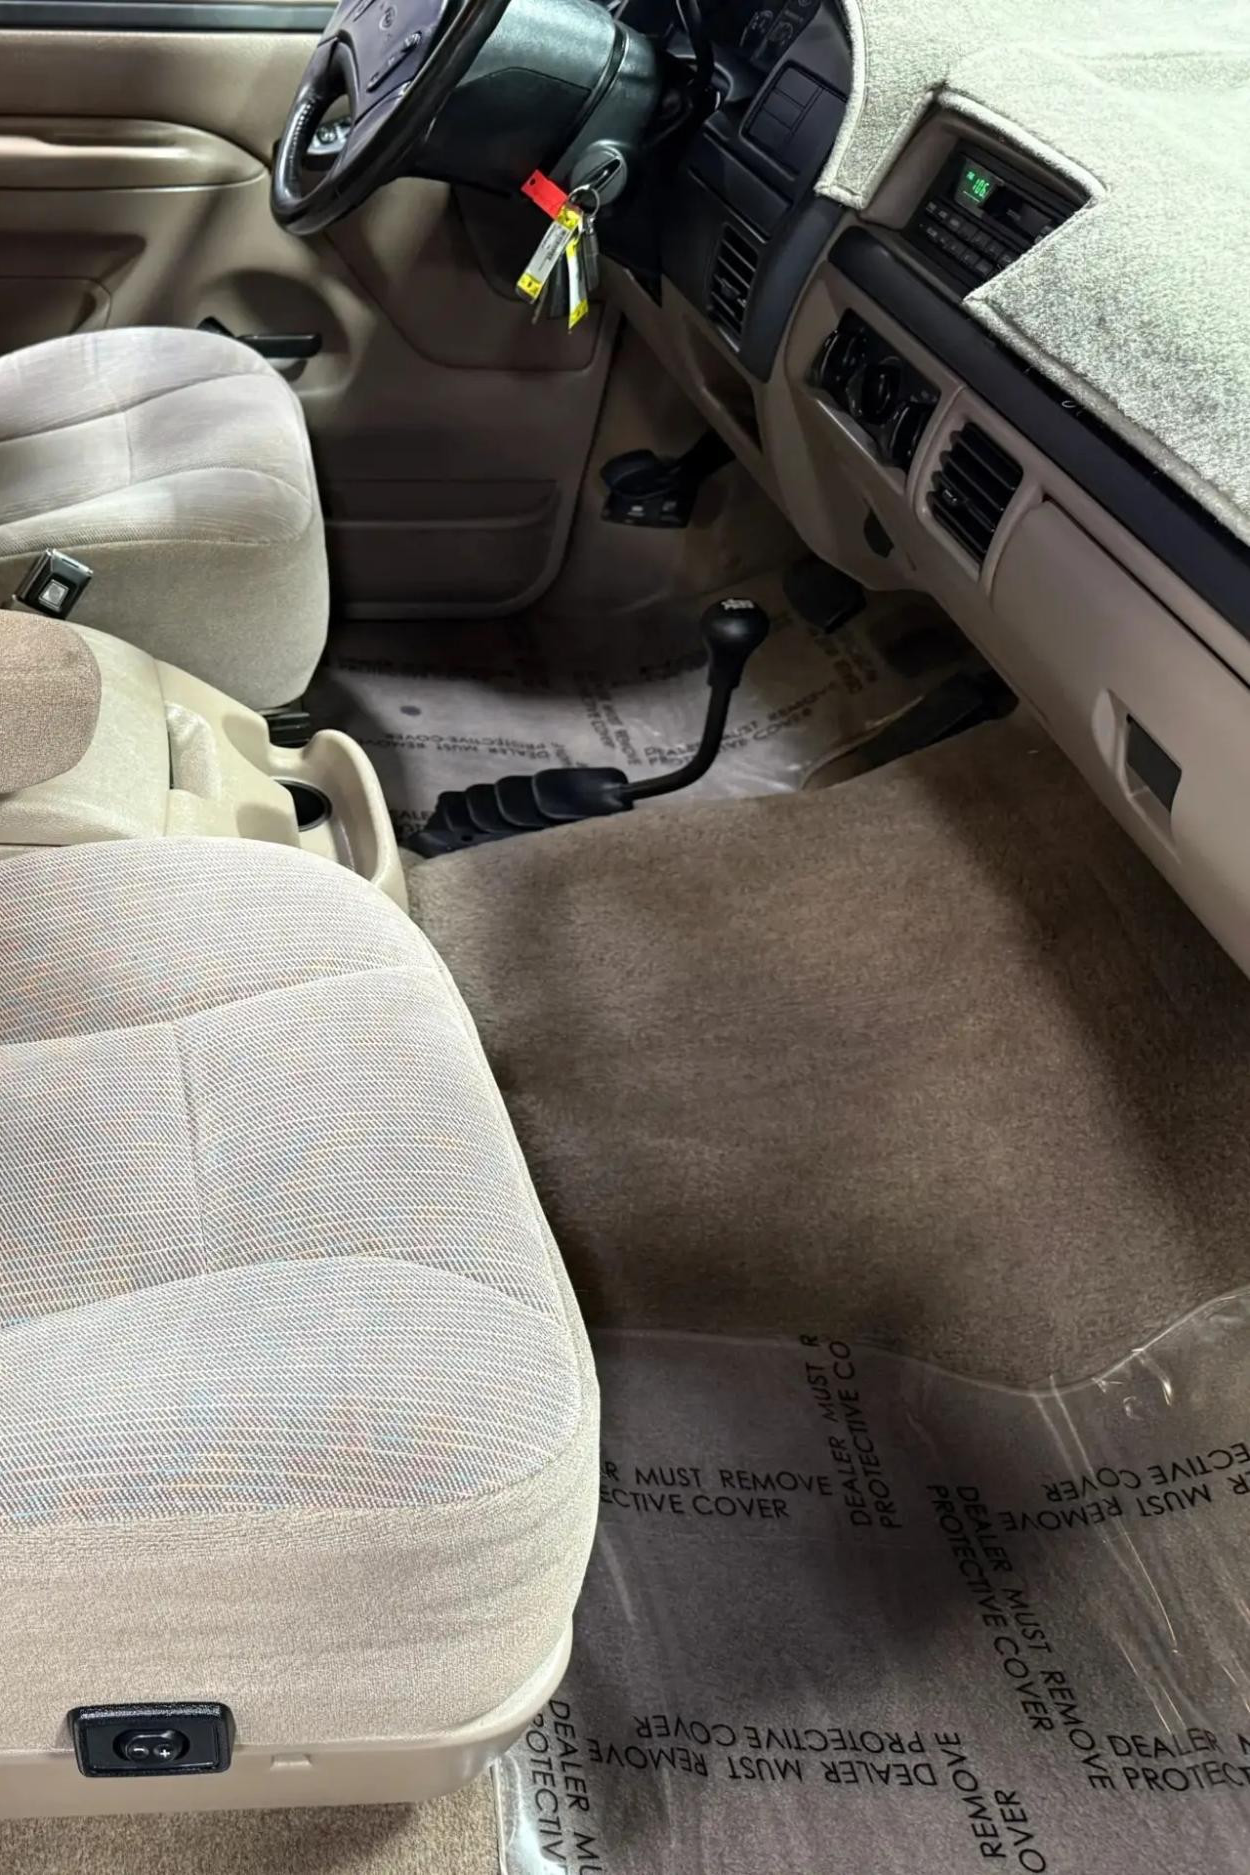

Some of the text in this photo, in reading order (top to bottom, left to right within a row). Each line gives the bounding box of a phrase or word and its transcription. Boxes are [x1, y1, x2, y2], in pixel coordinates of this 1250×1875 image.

[805, 1362, 838, 1422] MUST
[635, 1467, 702, 1489] MUST
[719, 1470, 834, 1495] REMOVE
[828, 1436, 872, 1527] DEALER
[837, 1389, 903, 1529] PROTECTIVE
[693, 1495, 790, 1519] COVER
[1042, 1467, 1141, 1502] COVER
[1136, 1484, 1212, 1517] MUST
[998, 1496, 1123, 1532] REMOVE
[926, 1485, 1054, 1731] PROTECTIVE COVER
[956, 1486, 1116, 1789] DEALER MUST REMOVE
[549, 1699, 590, 1812] DEALER
[633, 1714, 925, 1754] PROTECTIVE COVER
[1107, 1728, 1224, 1758] DEALER
[585, 1737, 938, 1786] DEALER MUST REMOVE
[934, 1732, 1006, 1858] REMOVE
